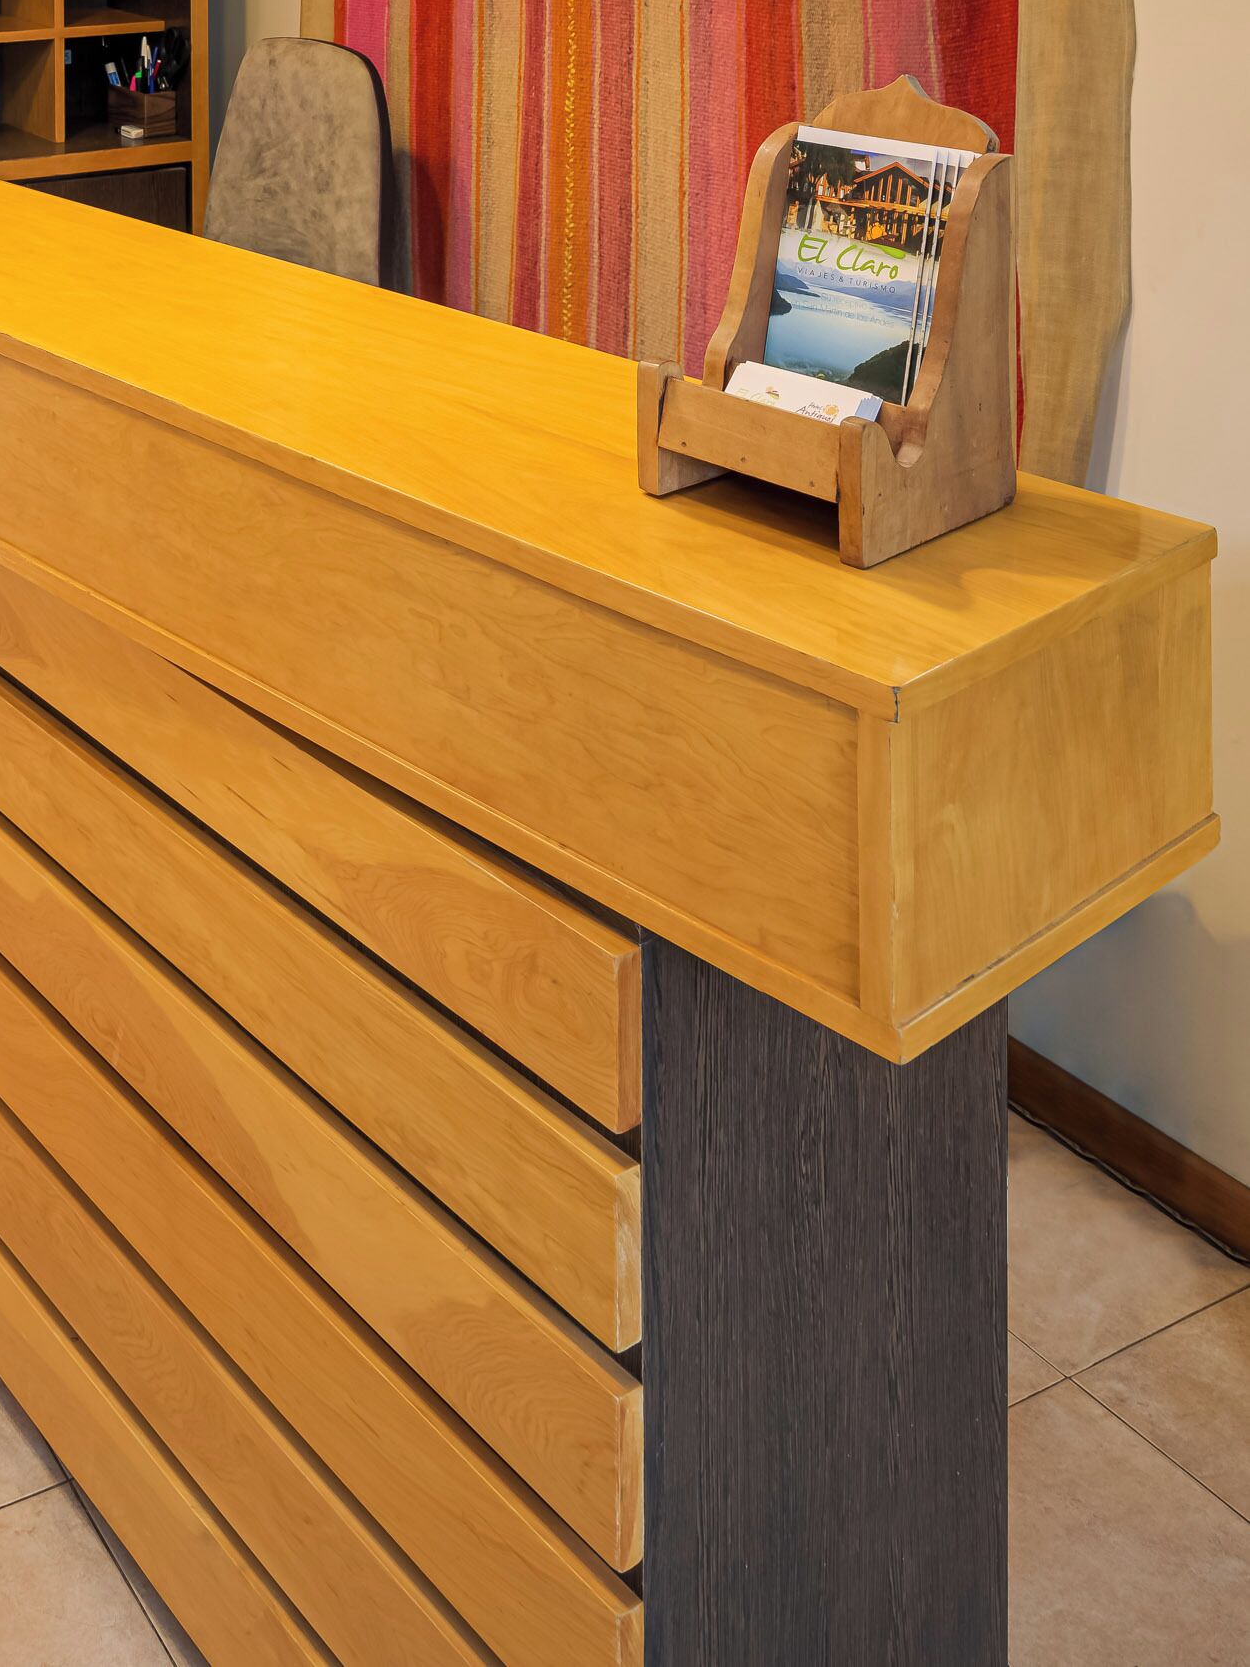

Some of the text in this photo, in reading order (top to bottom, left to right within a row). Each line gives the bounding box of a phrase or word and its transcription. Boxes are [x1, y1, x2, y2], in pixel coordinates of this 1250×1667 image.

[797, 234, 899, 280] El Claro
[798, 266, 835, 281] VIAJES
[849, 278, 896, 294] TURISMO
